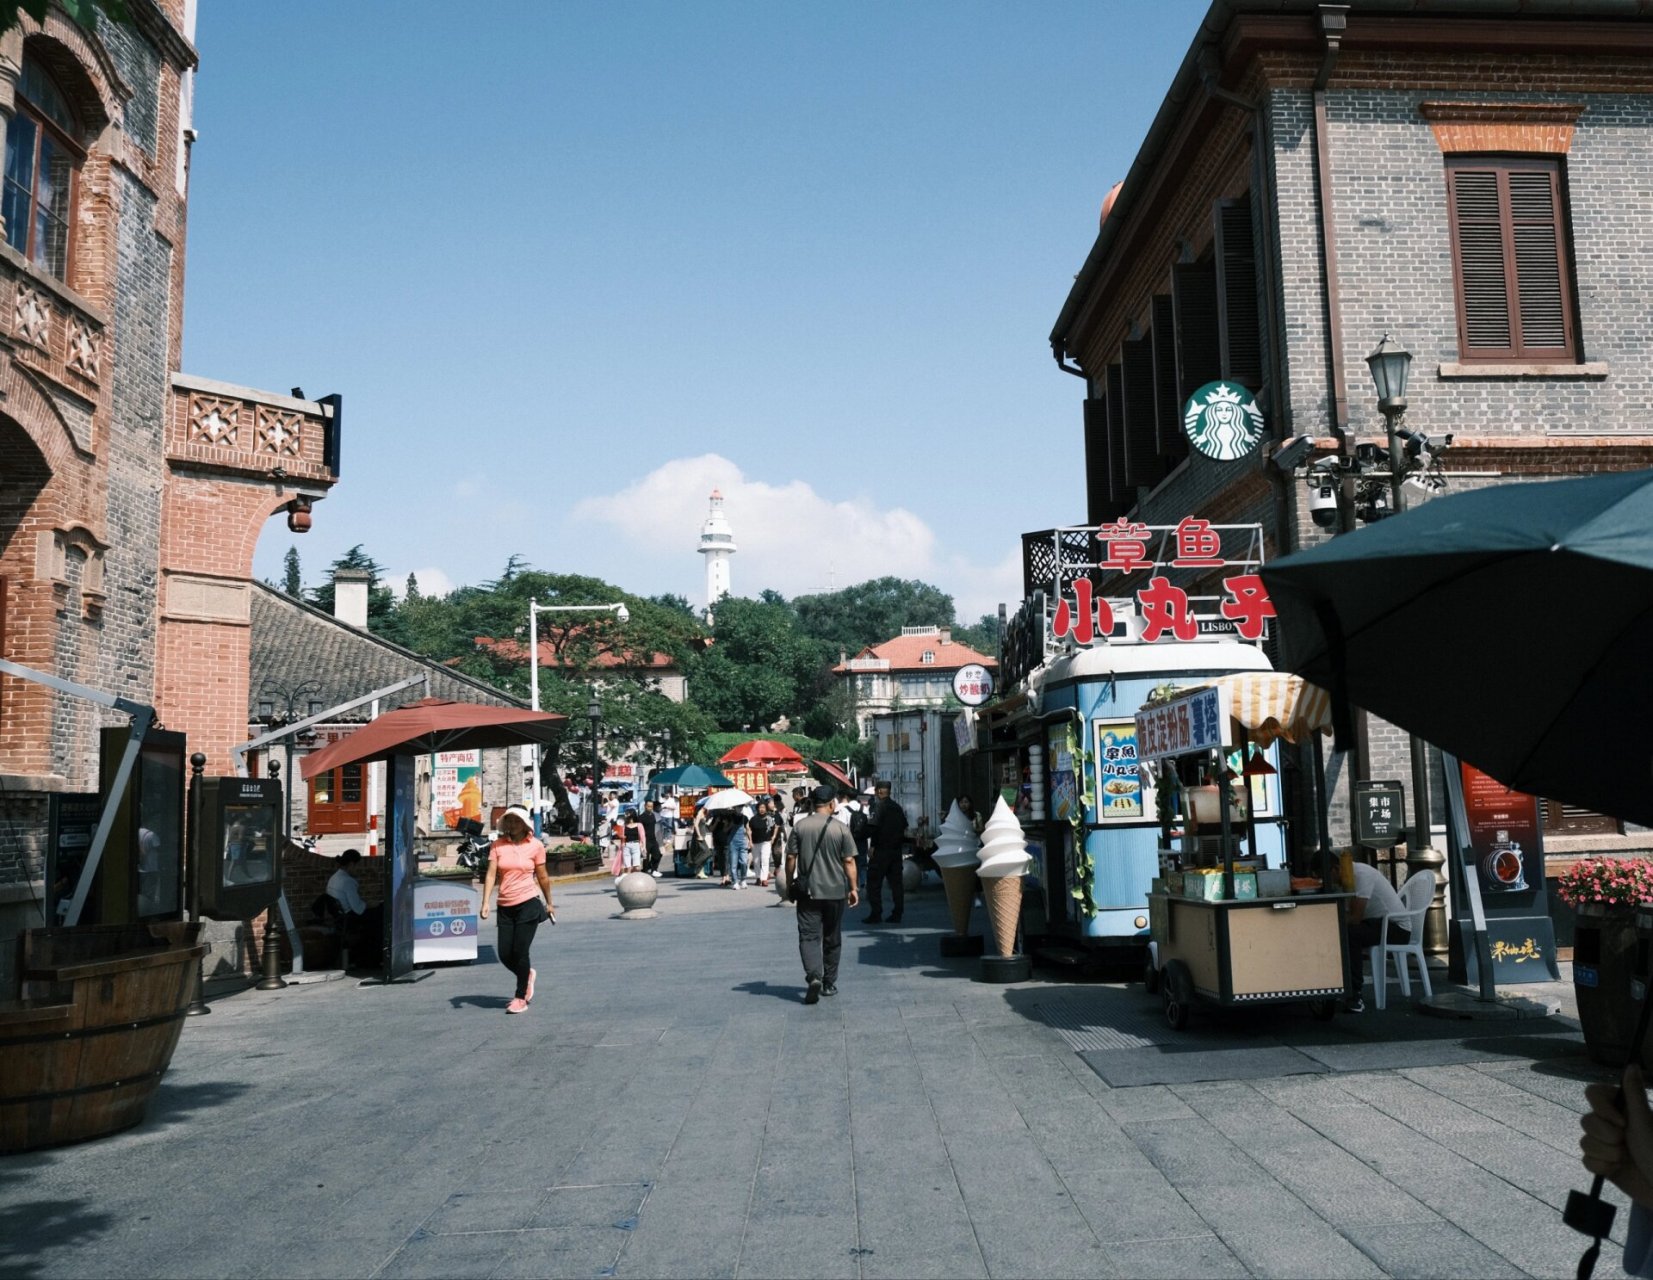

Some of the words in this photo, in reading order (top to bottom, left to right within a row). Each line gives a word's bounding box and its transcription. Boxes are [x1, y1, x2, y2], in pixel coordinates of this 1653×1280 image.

[1095, 515, 1225, 574] 章鱼
[1053, 575, 1278, 645] 小丸子
[1201, 622, 1236, 633] LISBO
[440, 752, 475, 764] 特产商店
[1369, 797, 1390, 807] 集市
[1370, 809, 1391, 819] 广场
